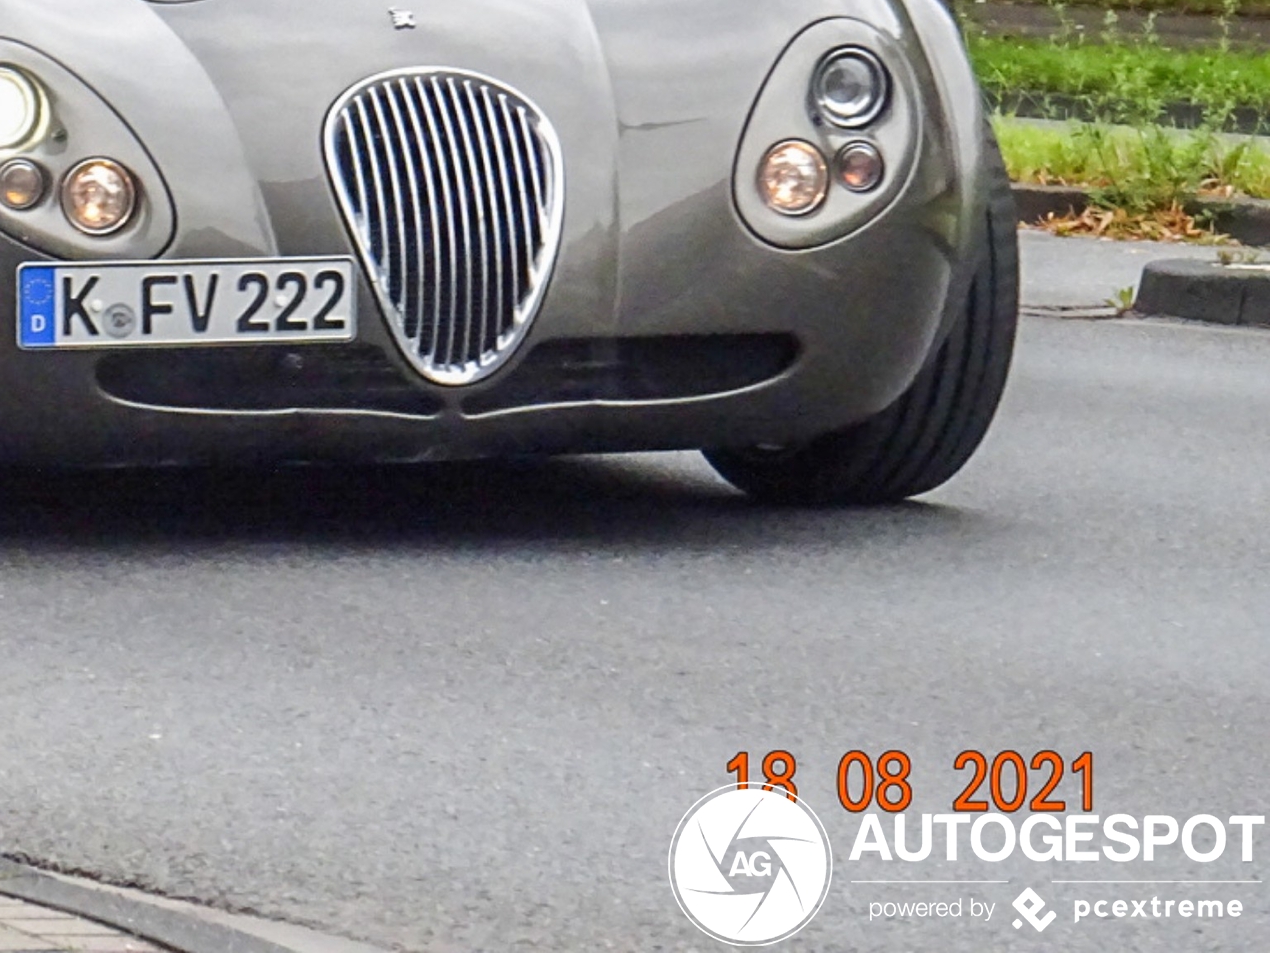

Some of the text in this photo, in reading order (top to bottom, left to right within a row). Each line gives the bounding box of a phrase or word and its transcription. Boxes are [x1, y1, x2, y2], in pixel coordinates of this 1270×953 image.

[31, 315, 46, 333] D
[62, 270, 345, 336] K FV 222
